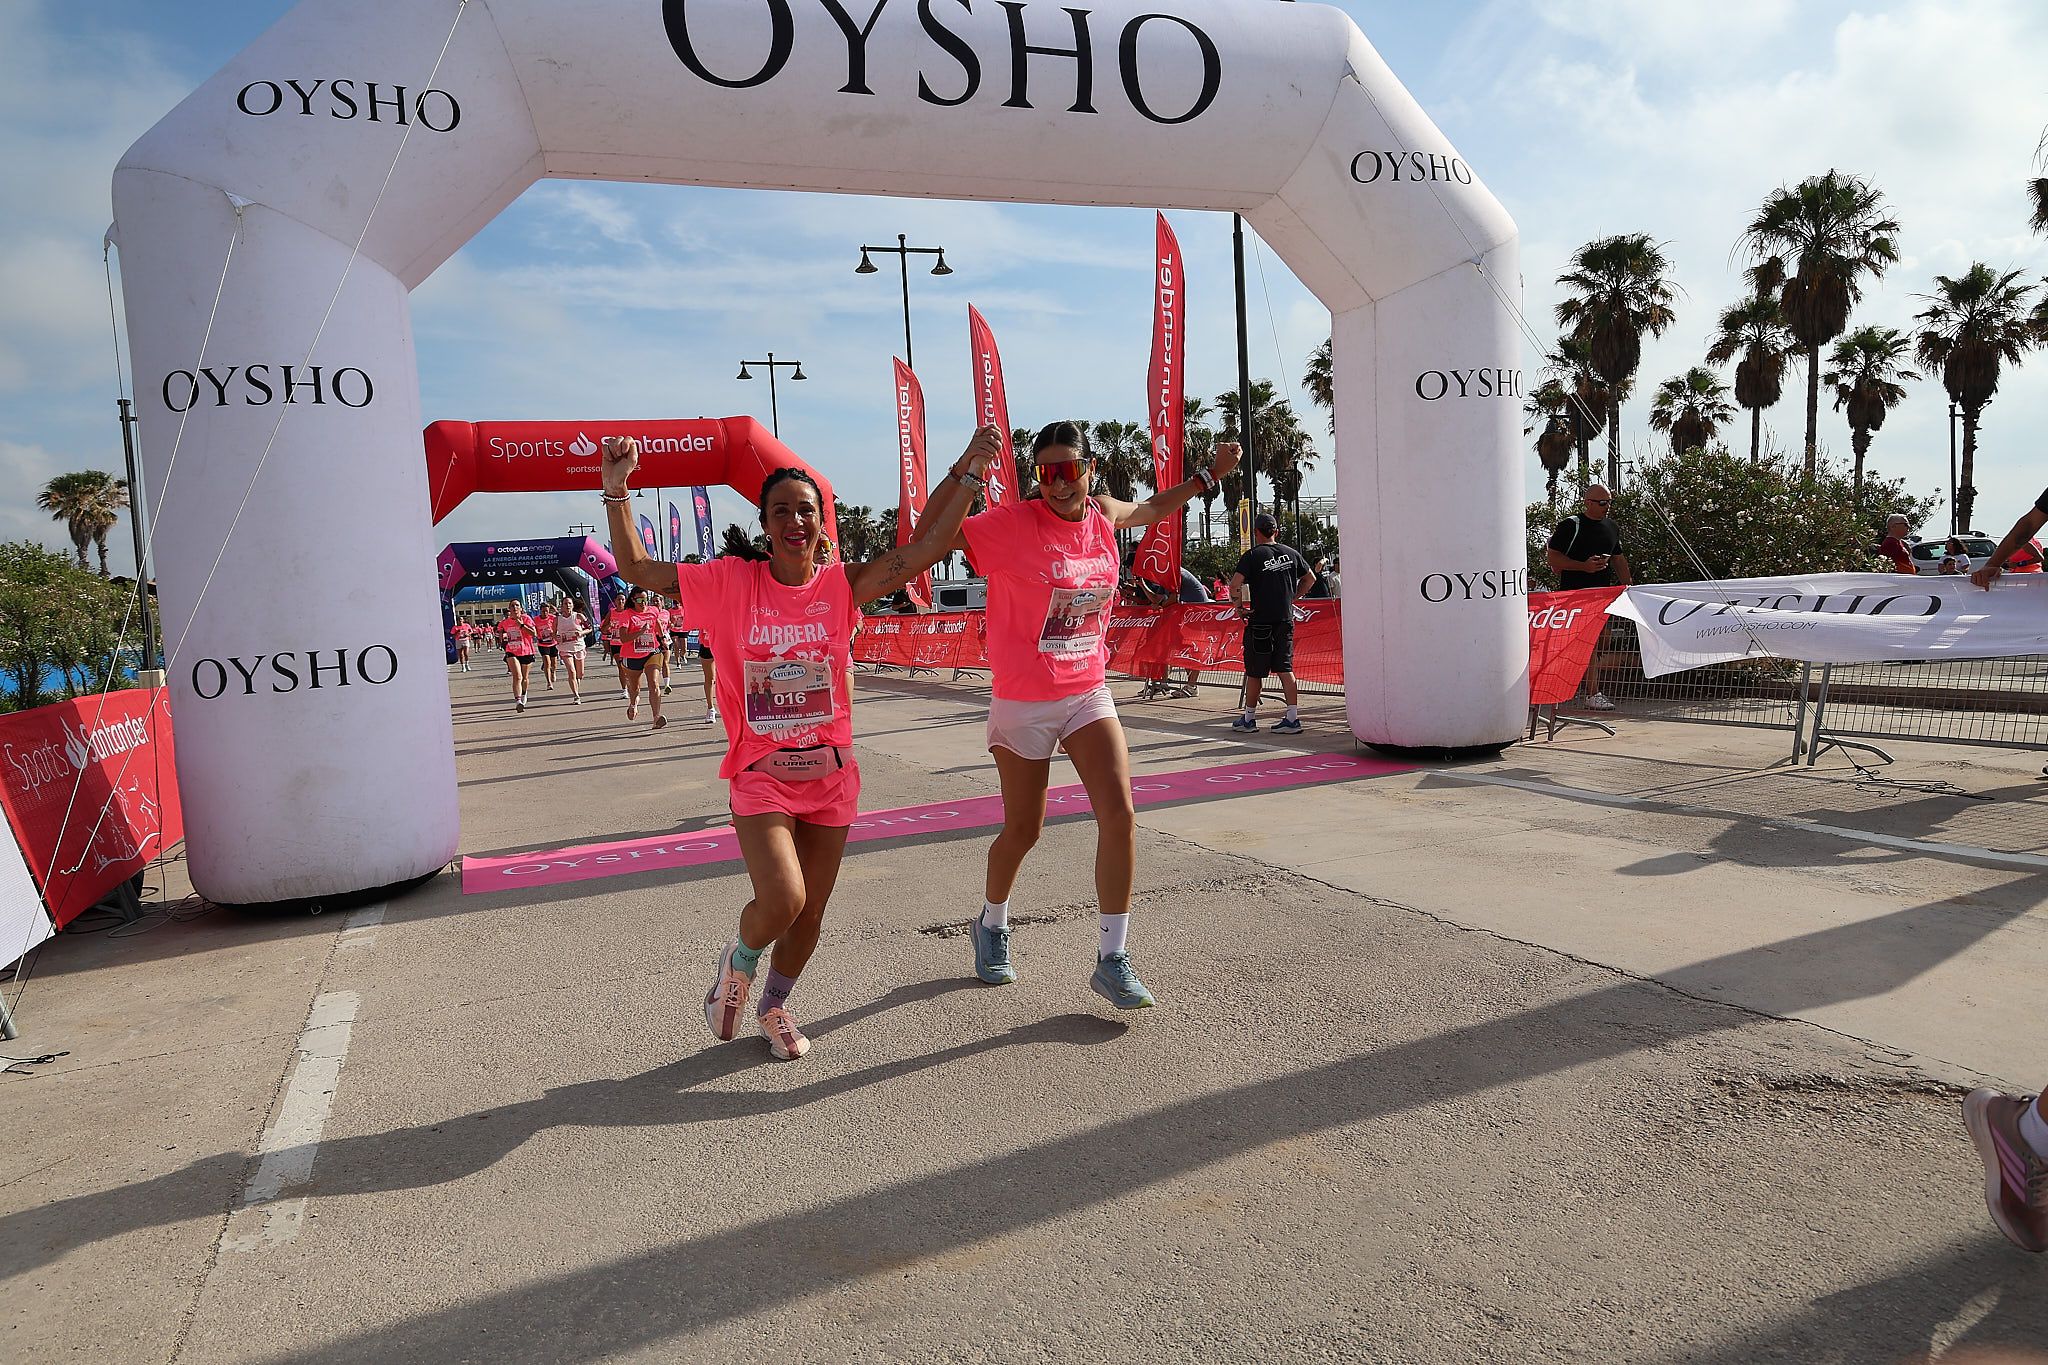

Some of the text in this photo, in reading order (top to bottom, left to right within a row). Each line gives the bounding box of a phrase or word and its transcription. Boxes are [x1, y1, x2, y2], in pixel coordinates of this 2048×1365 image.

[661, 0, 1222, 125] OYSHO
[236, 79, 462, 133] OYSHO
[1350, 150, 1473, 187] OYSHO
[162, 363, 374, 413] OYSHO
[1415, 368, 1524, 401] OYSHO
[489, 433, 715, 463] Sports ntander
[497, 544, 554, 554] octopus energy
[1420, 568, 1526, 603] OYSHO
[748, 622, 830, 646] CARRERA
[192, 644, 399, 700] OYSHO
[773, 691, 807, 706] 016
[4, 712, 150, 800] Sports Santander
[796, 732, 818, 749] 2026
[1206, 761, 1358, 783] OYSHO
[850, 811, 960, 829] SHO
[502, 841, 719, 876] OYSHO
